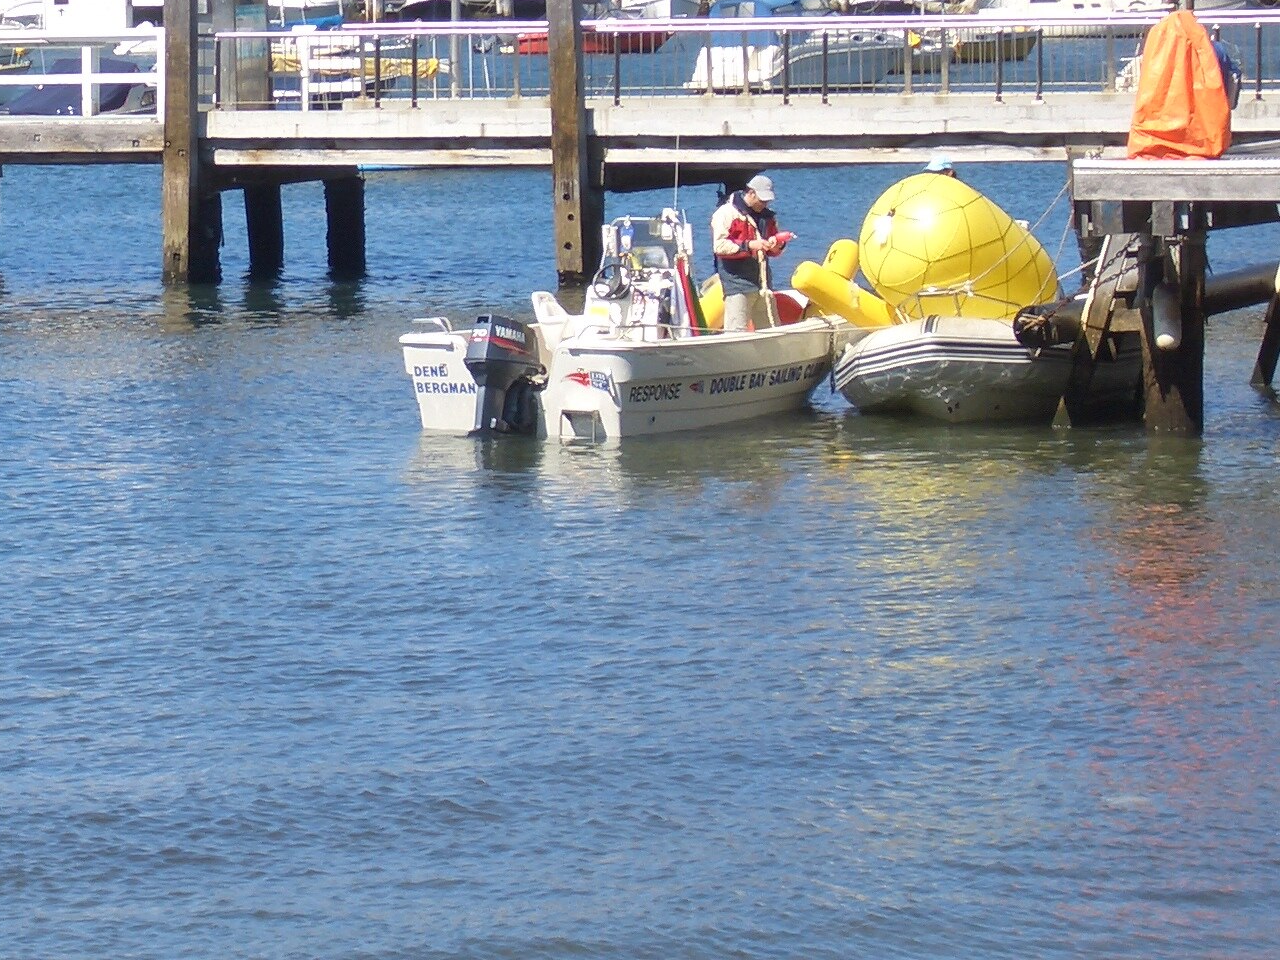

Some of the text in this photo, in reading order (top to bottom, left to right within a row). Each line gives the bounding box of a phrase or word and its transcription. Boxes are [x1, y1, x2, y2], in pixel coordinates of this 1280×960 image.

[494, 324, 526, 344] YAMAHA
[416, 382, 477, 394] BERGMAN
[710, 375, 747, 395] DOUBLE
[748, 372, 768, 389] BAY
[768, 366, 803, 386] SAILING
[629, 383, 682, 403] RESPONSE
